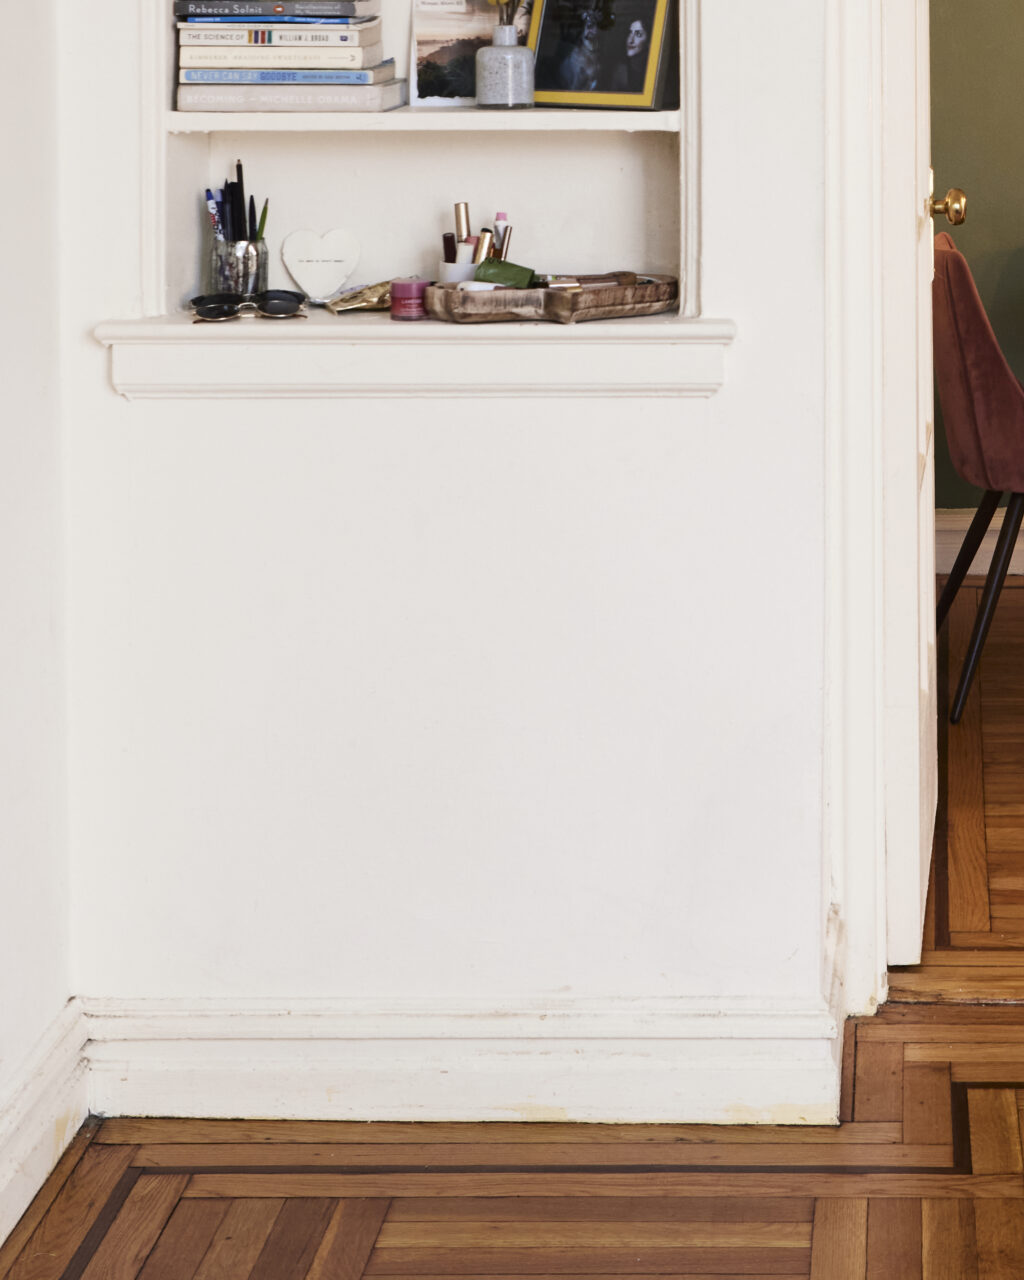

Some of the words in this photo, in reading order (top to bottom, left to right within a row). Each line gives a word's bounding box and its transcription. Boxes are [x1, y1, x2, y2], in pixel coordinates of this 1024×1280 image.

[188, 4, 230, 14] Rebecca
[232, 4, 263, 14] Solnit
[203, 33, 233, 41] SCIENCE
[234, 33, 245, 41] OF
[311, 34, 329, 42] BROAD
[191, 71, 220, 80] NEVER
[222, 71, 240, 80] CAN
[259, 72, 297, 81] GOODBYE
[186, 95, 245, 104] BECOMING
[260, 95, 313, 104] MICHELLE
[319, 95, 358, 105] OBAMA
